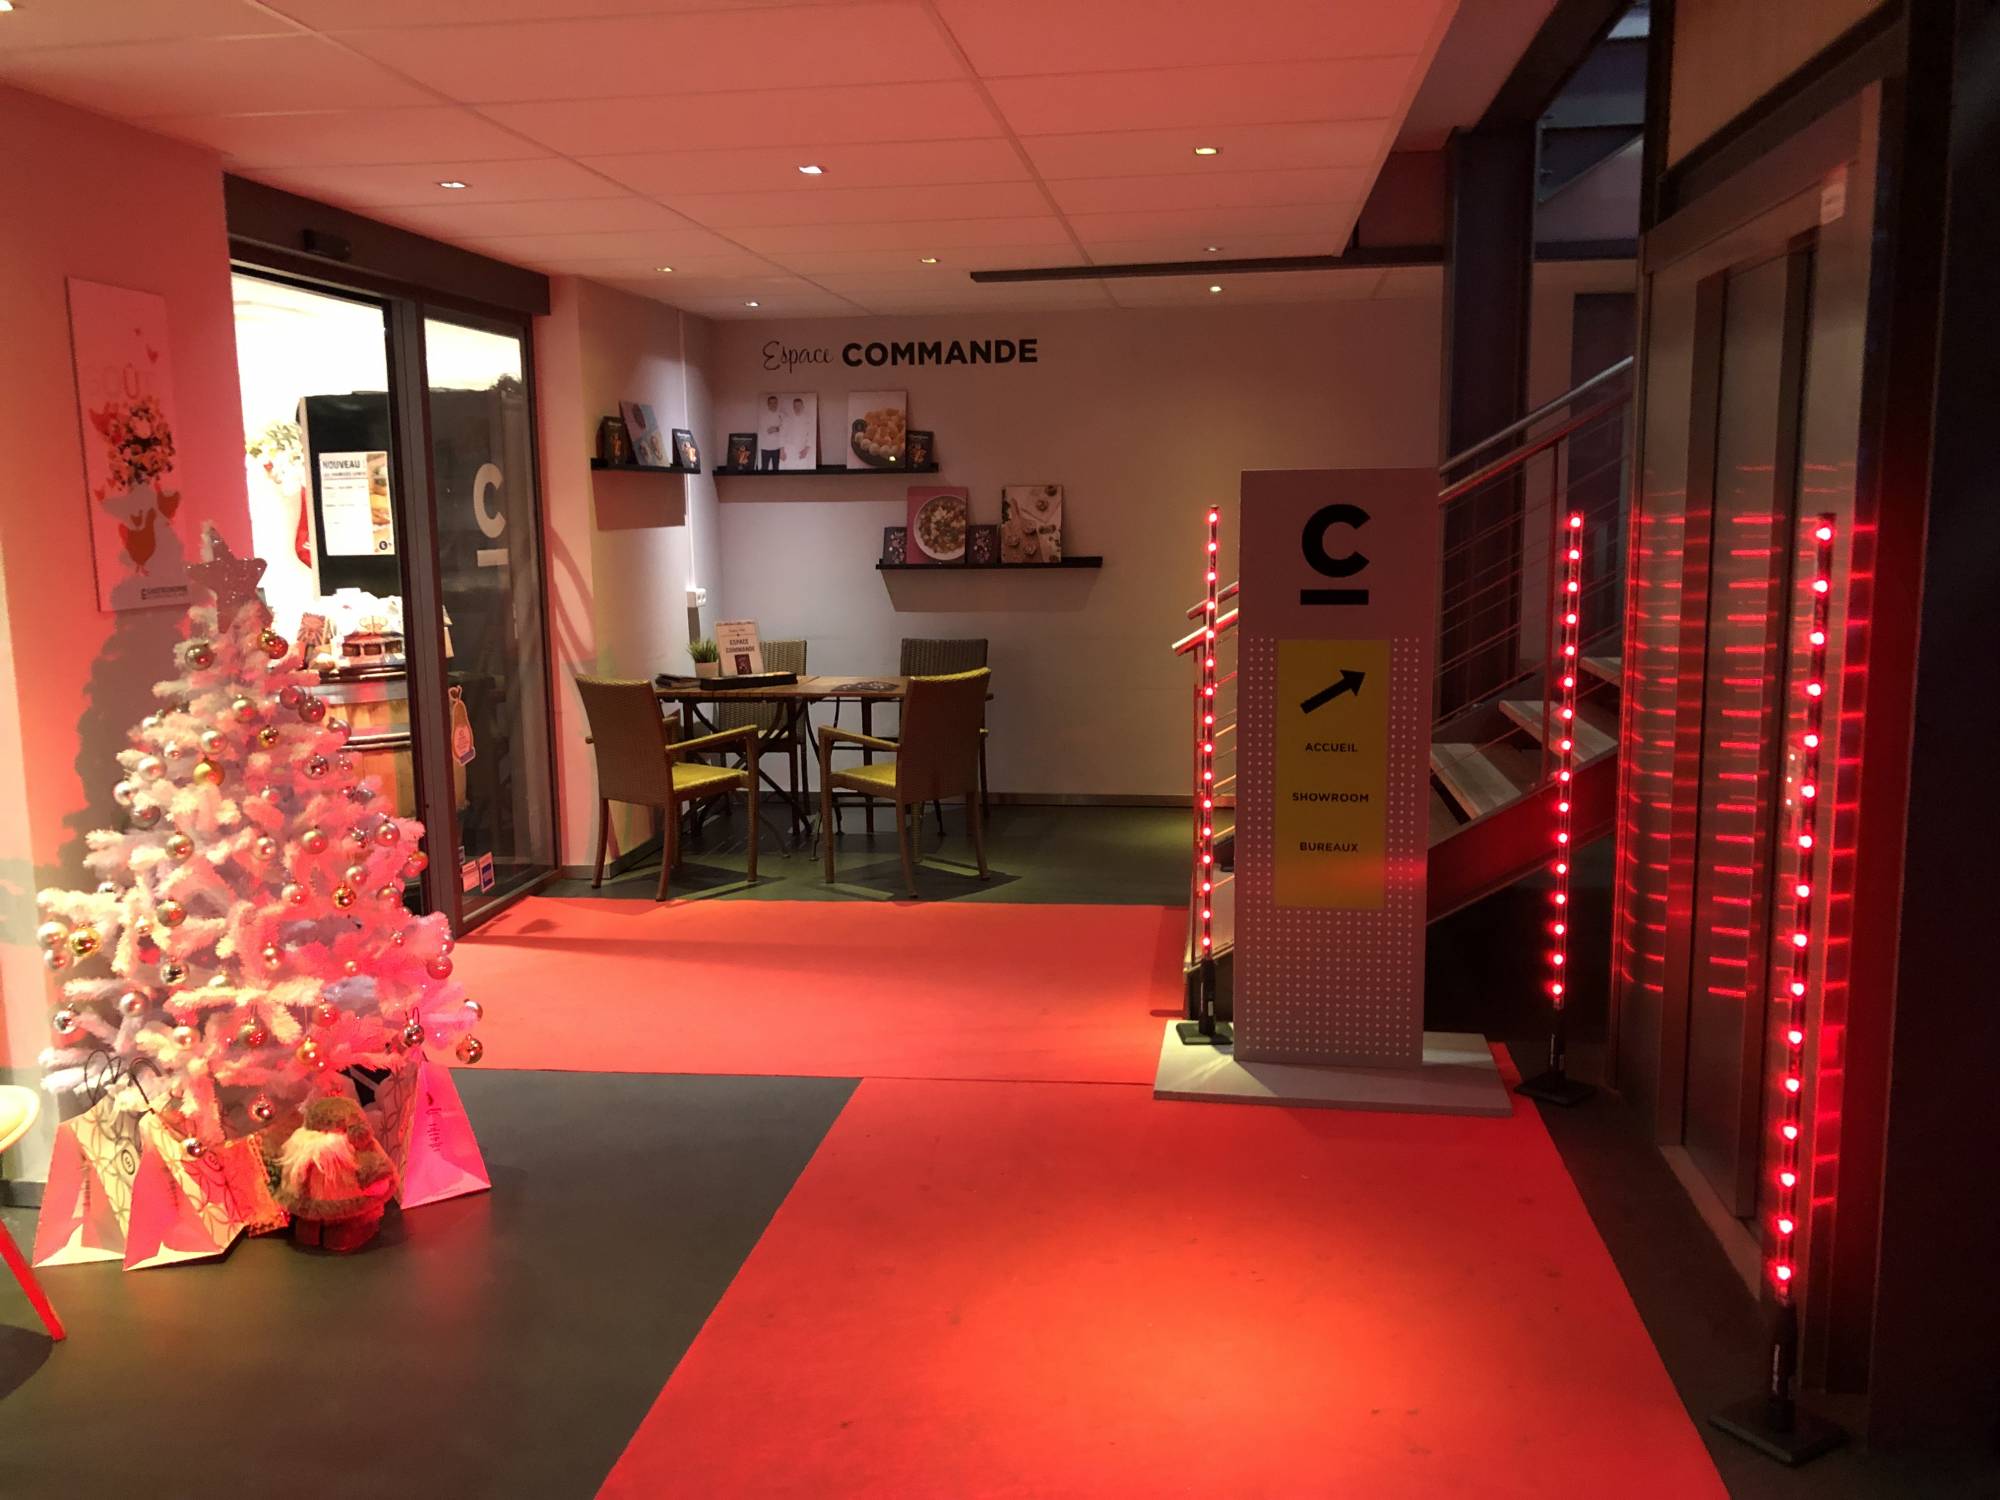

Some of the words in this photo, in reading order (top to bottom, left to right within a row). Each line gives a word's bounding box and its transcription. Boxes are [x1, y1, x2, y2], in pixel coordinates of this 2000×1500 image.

[762, 340, 834, 374] Espace
[842, 338, 1038, 367] COMMANDE
[322, 459, 361, 469] NOUVEAU
[473, 463, 506, 538] C
[1301, 503, 1371, 578] C
[1305, 743, 1358, 752] ACCUEIL
[1292, 792, 1369, 803] SHOWROOM
[1299, 842, 1360, 853] BUREAUX
